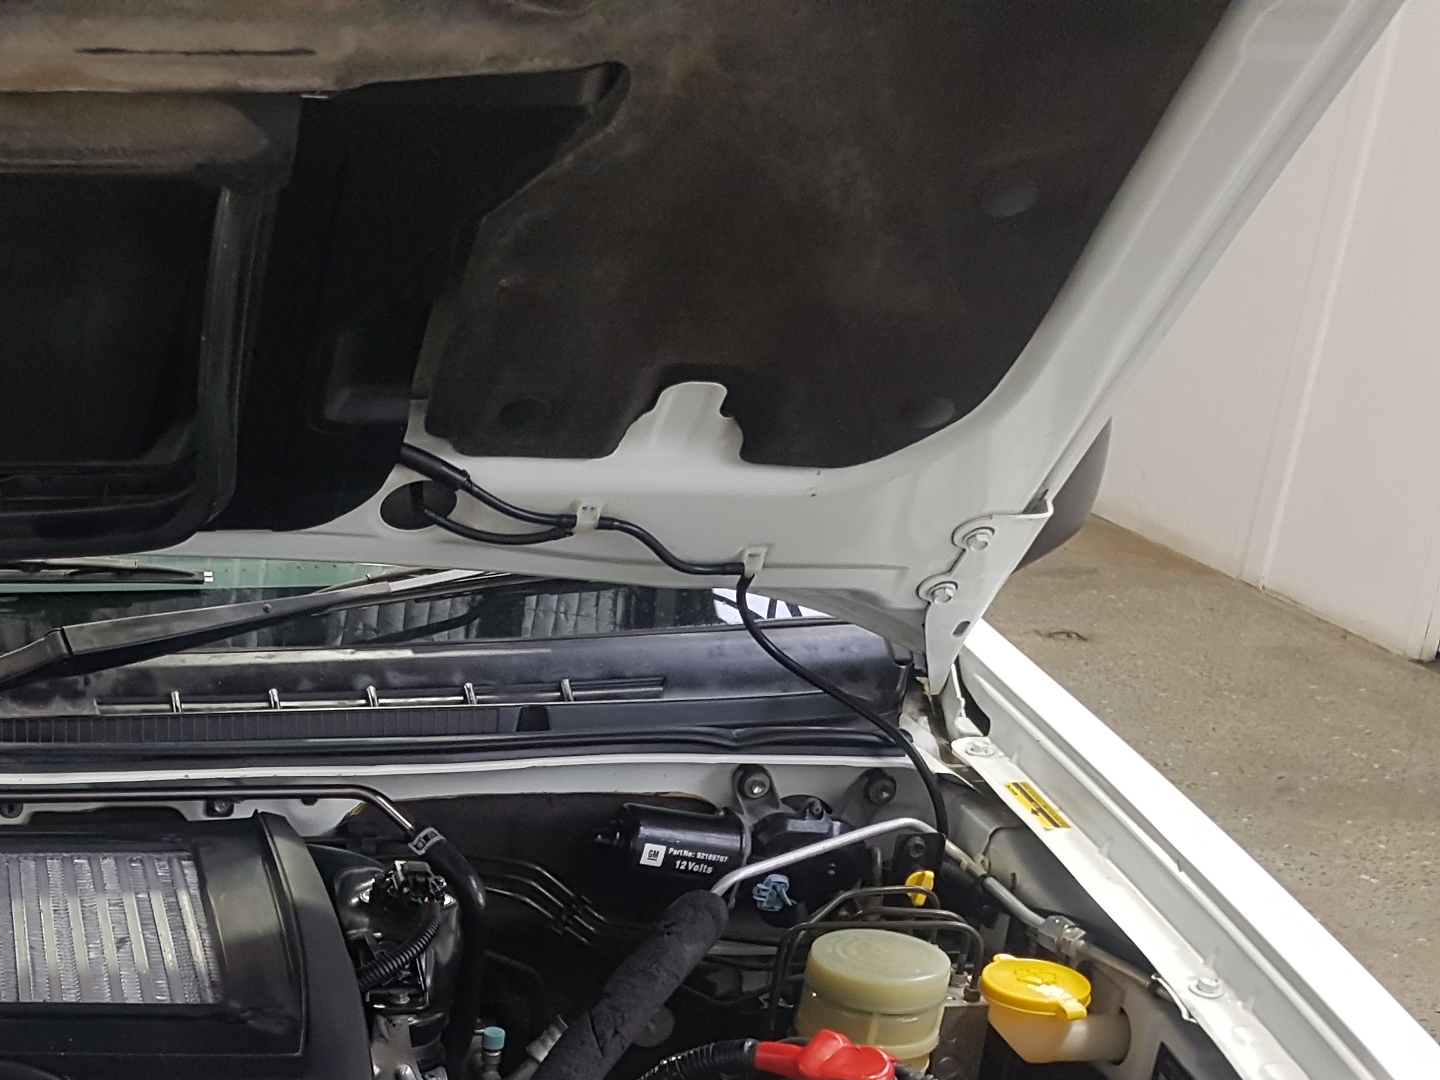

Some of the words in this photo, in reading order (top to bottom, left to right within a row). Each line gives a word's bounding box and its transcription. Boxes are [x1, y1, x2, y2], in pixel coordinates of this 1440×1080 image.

[648, 849, 659, 858] GM
[675, 860, 687, 870] 12
[687, 862, 713, 874] Volts
